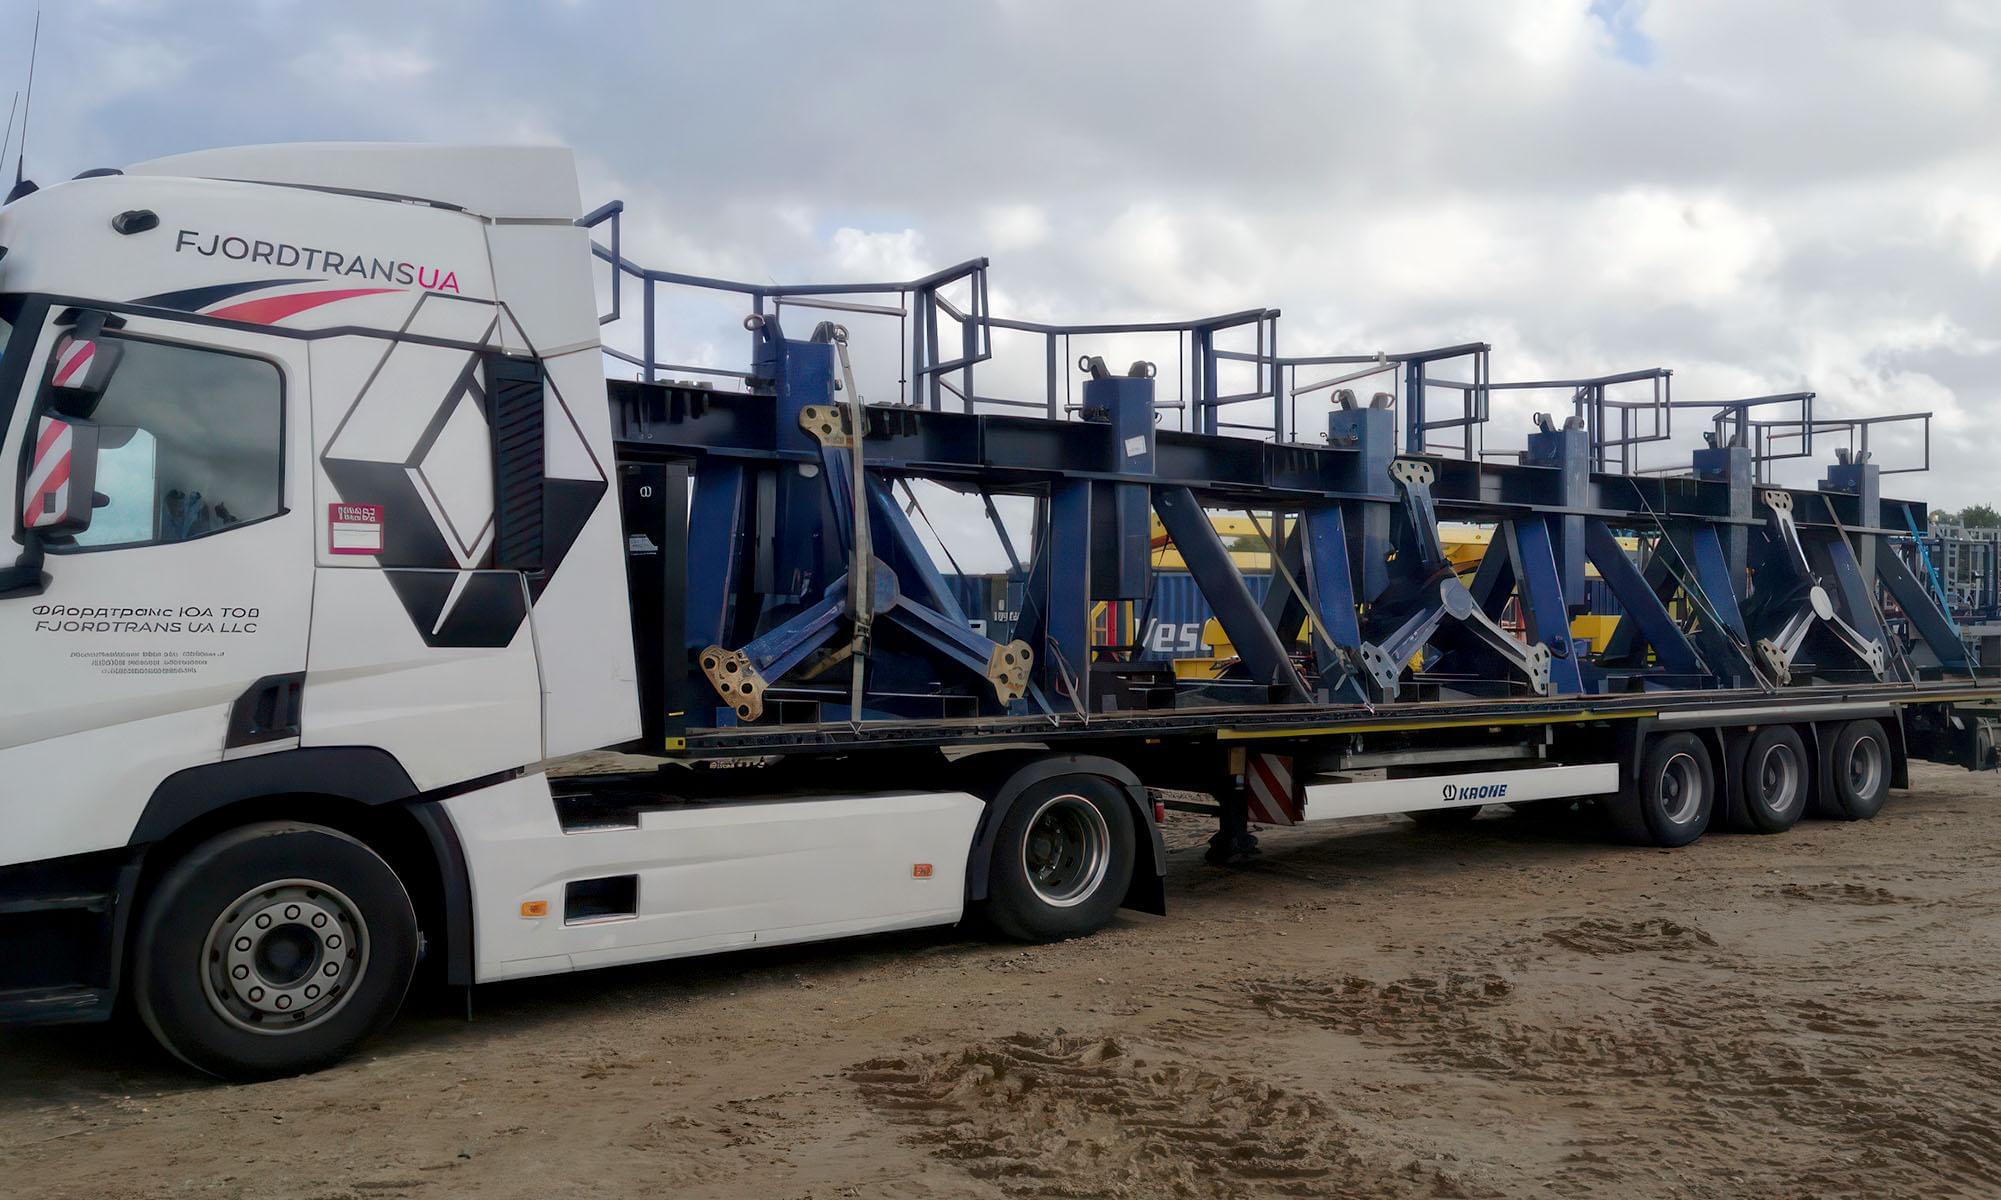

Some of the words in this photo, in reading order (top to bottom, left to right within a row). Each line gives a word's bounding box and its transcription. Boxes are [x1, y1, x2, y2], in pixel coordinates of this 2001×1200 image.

[175, 229, 460, 294] FJORDTRANSUA
[35, 620, 182, 633] FJORDTRANS
[188, 622, 215, 633] UA
[220, 622, 257, 633] LLC
